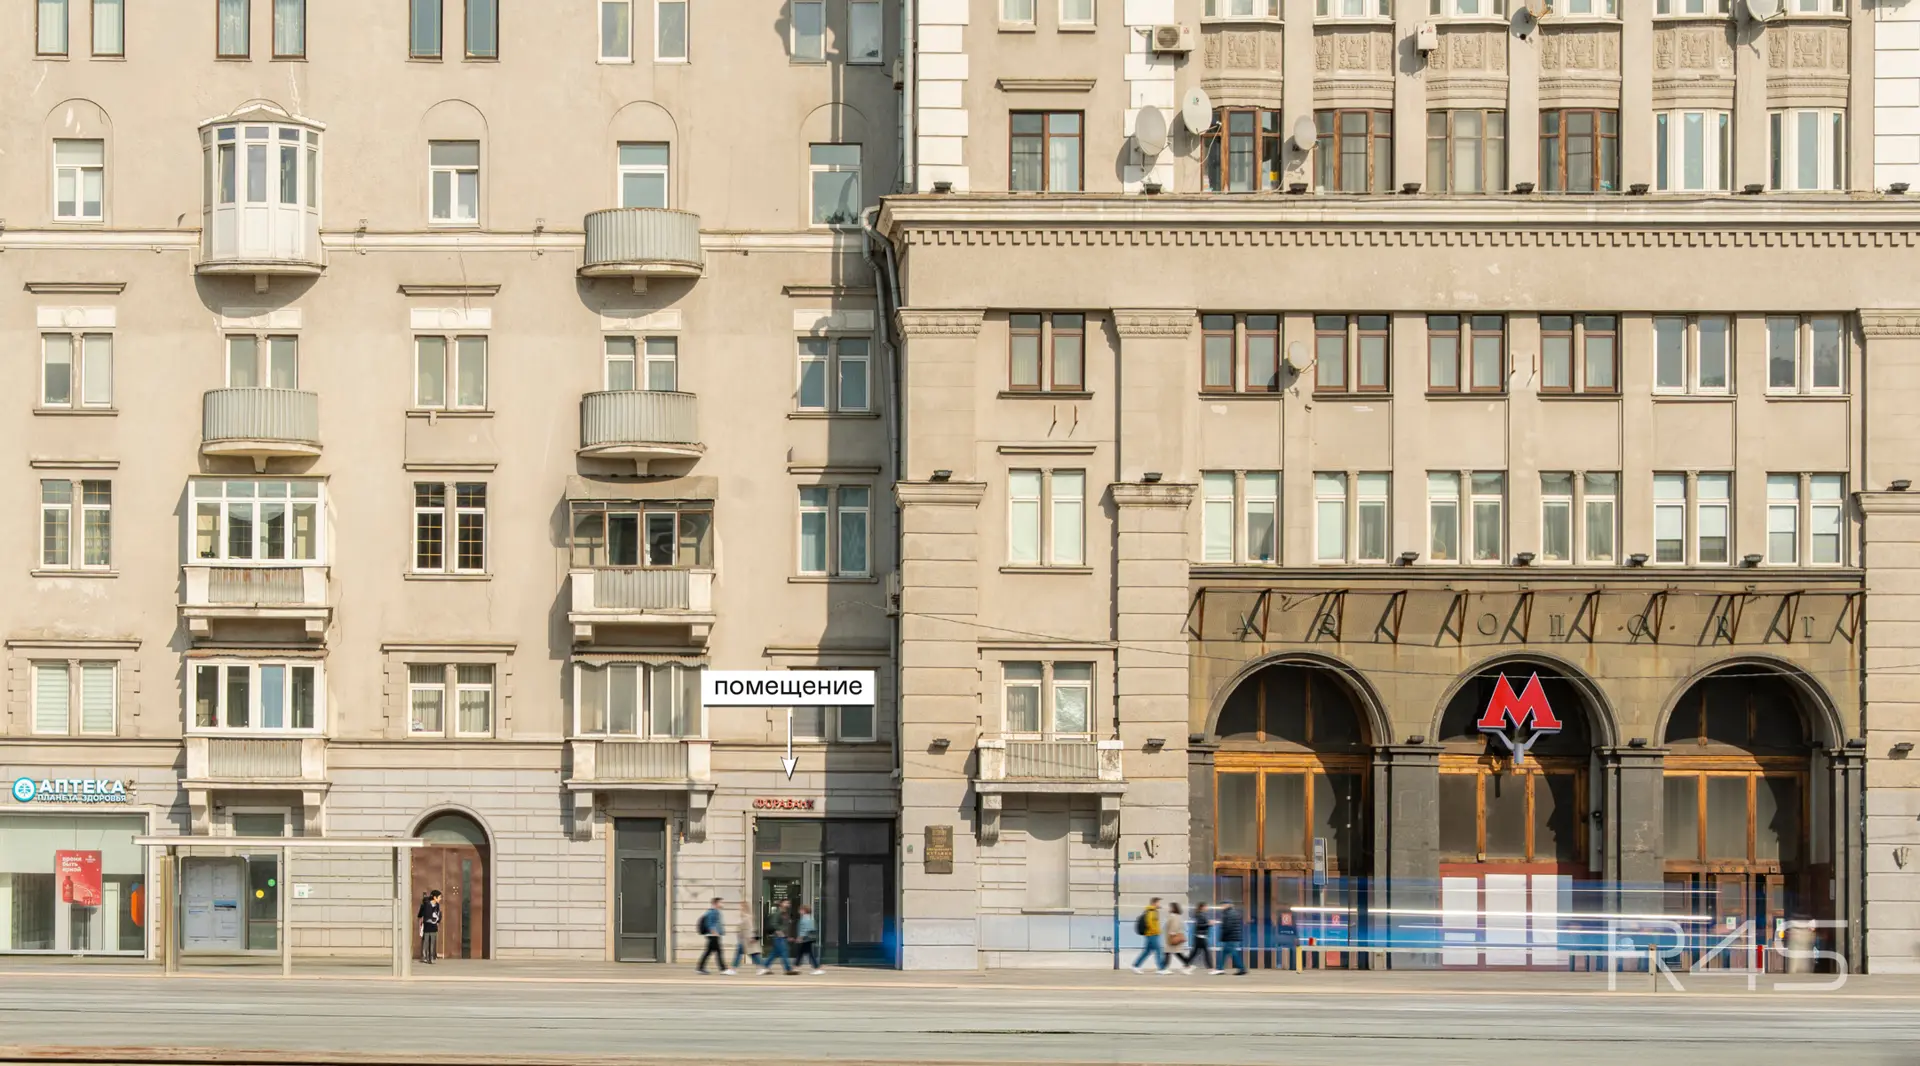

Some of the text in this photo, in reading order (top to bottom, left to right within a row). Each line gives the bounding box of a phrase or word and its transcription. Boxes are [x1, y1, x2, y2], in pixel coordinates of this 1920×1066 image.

[39, 779, 126, 794] АПТЕКА
[37, 794, 127, 804] ПЛАНЕТА ЗДОРОВЬЯ
